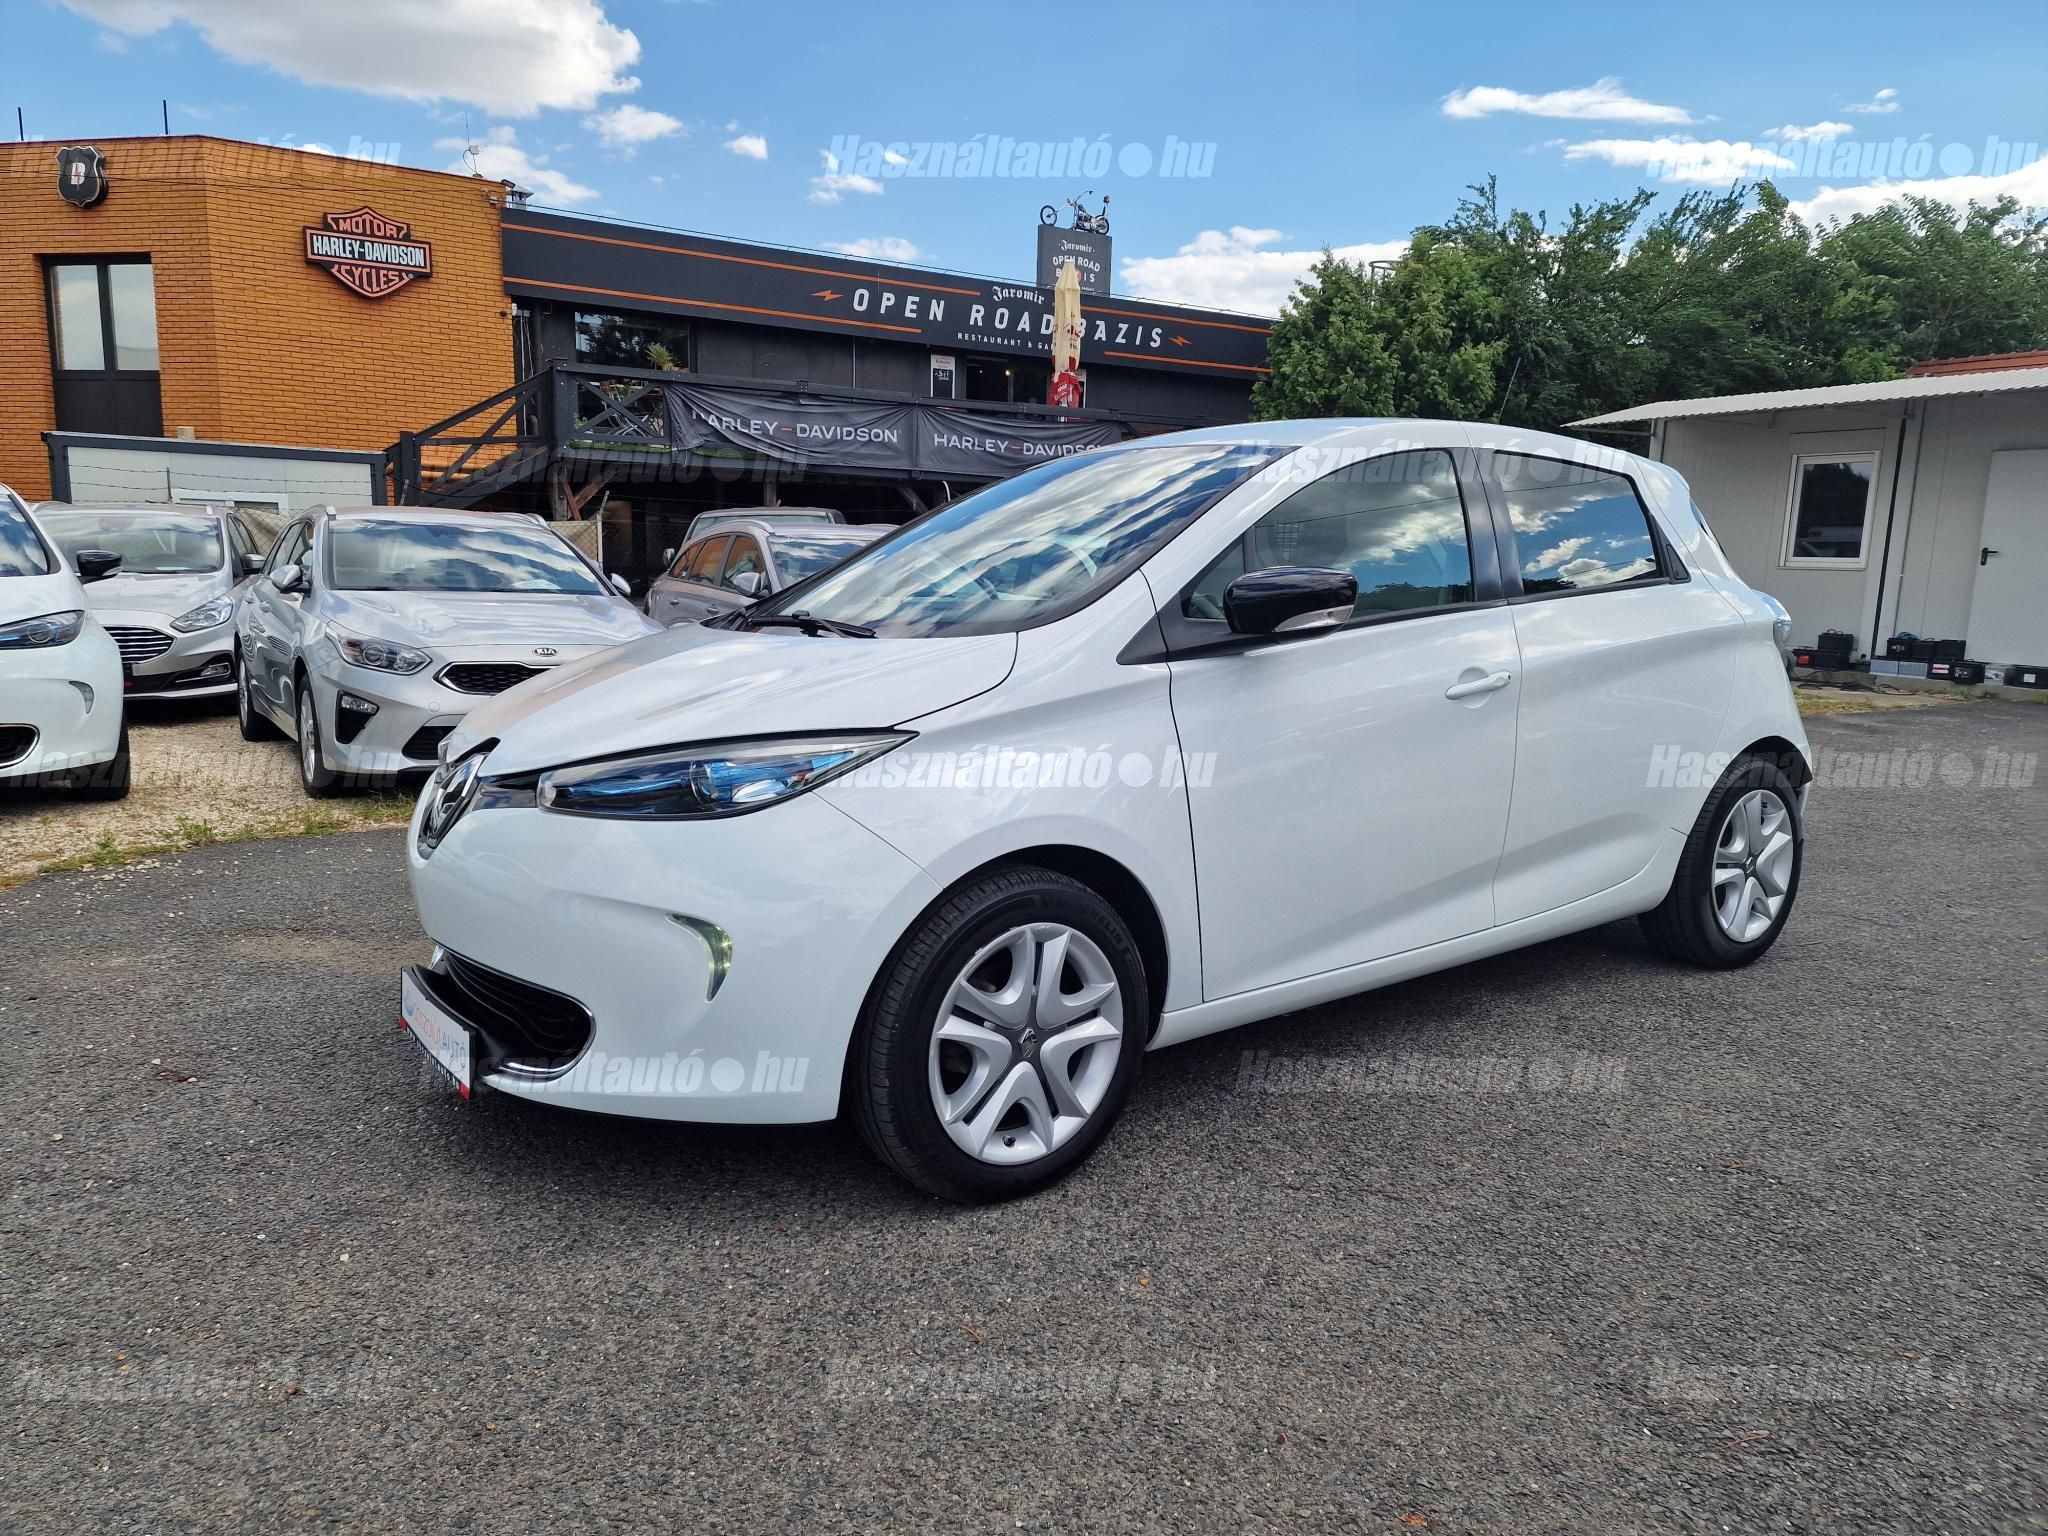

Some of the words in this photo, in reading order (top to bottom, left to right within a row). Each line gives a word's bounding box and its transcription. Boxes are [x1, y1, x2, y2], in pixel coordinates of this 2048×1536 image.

[71, 162, 86, 185] B
[339, 213, 398, 239] MOTOR
[312, 234, 425, 267] HARLEY-DAVIDSON
[1055, 267, 1096, 283] BIS
[1077, 256, 1101, 273] ROAD
[340, 264, 400, 293] CYCLES
[992, 285, 1045, 305] Jaromir
[852, 287, 945, 323] OPEN
[969, 303, 1055, 336] ROAD
[957, 332, 1021, 347] RESTAURANT
[934, 433, 1101, 457] HARLEY-DAVIDS
[537, 647, 556, 656] KIA
